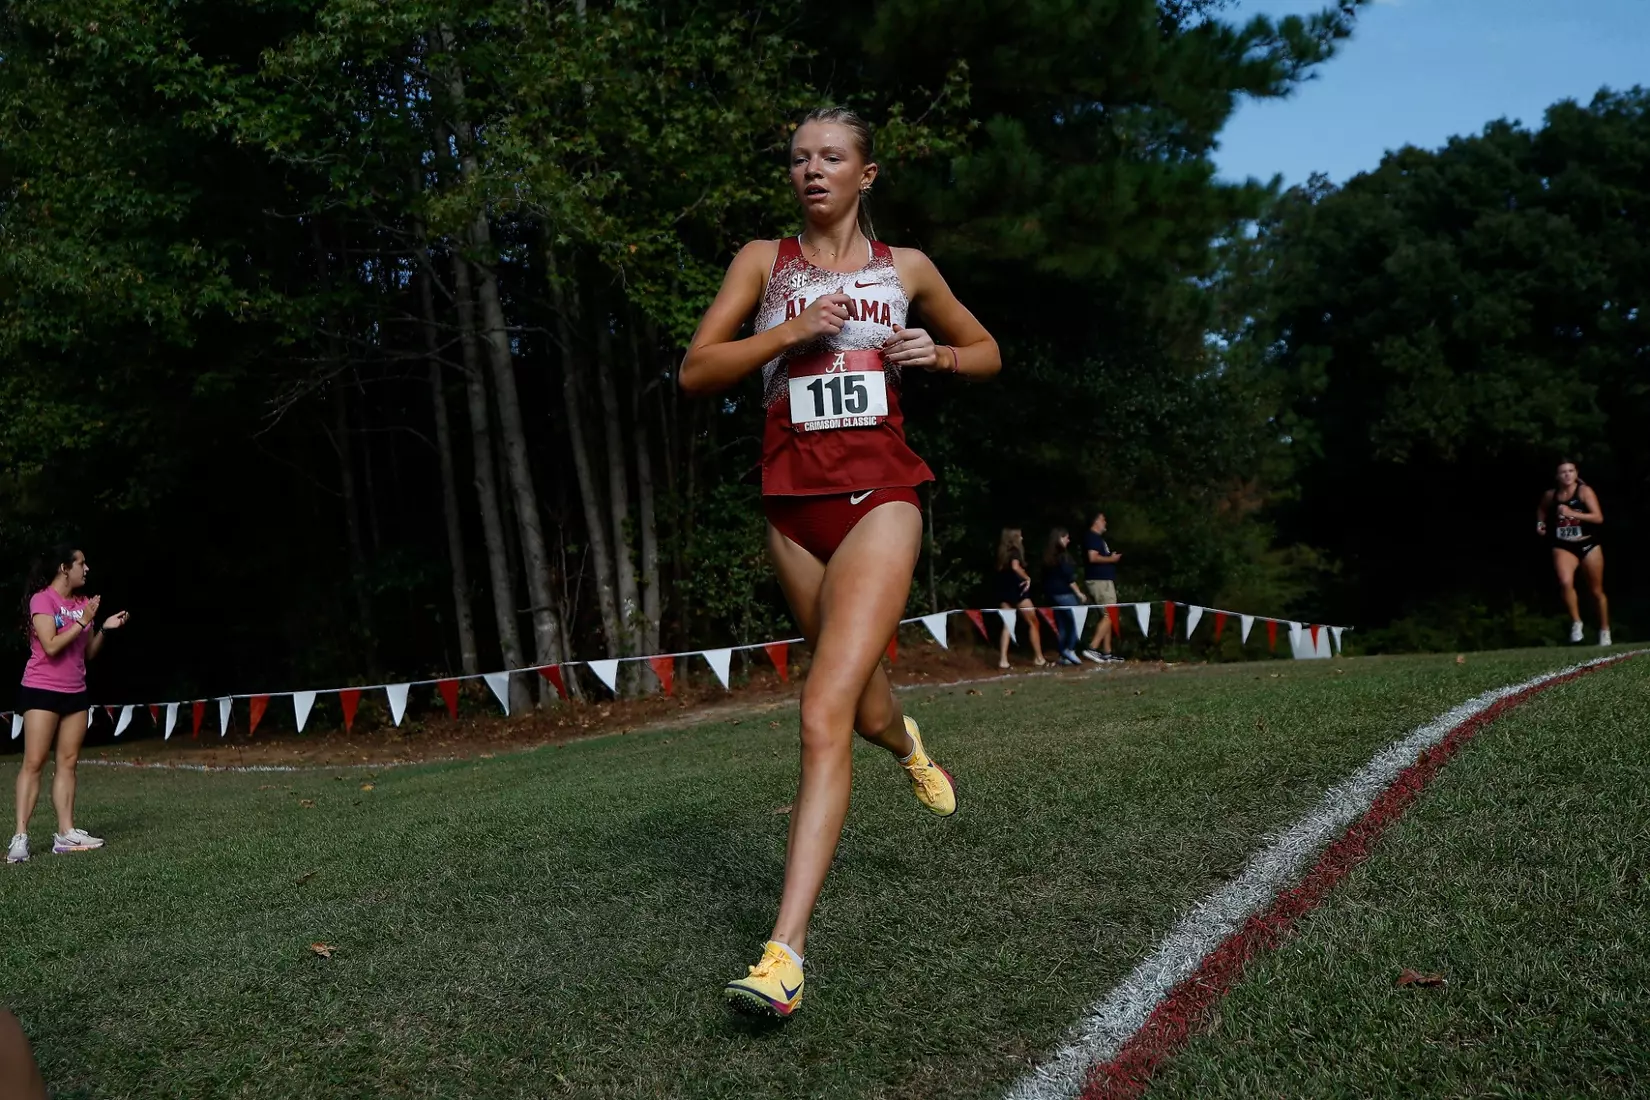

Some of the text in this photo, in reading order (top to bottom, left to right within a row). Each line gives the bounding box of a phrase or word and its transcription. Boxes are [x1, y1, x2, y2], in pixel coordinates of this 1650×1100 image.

[791, 273, 808, 288] SEC
[825, 352, 847, 373] A
[807, 375, 868, 417] 115
[804, 416, 877, 431] CRIMSON CLASSIC
